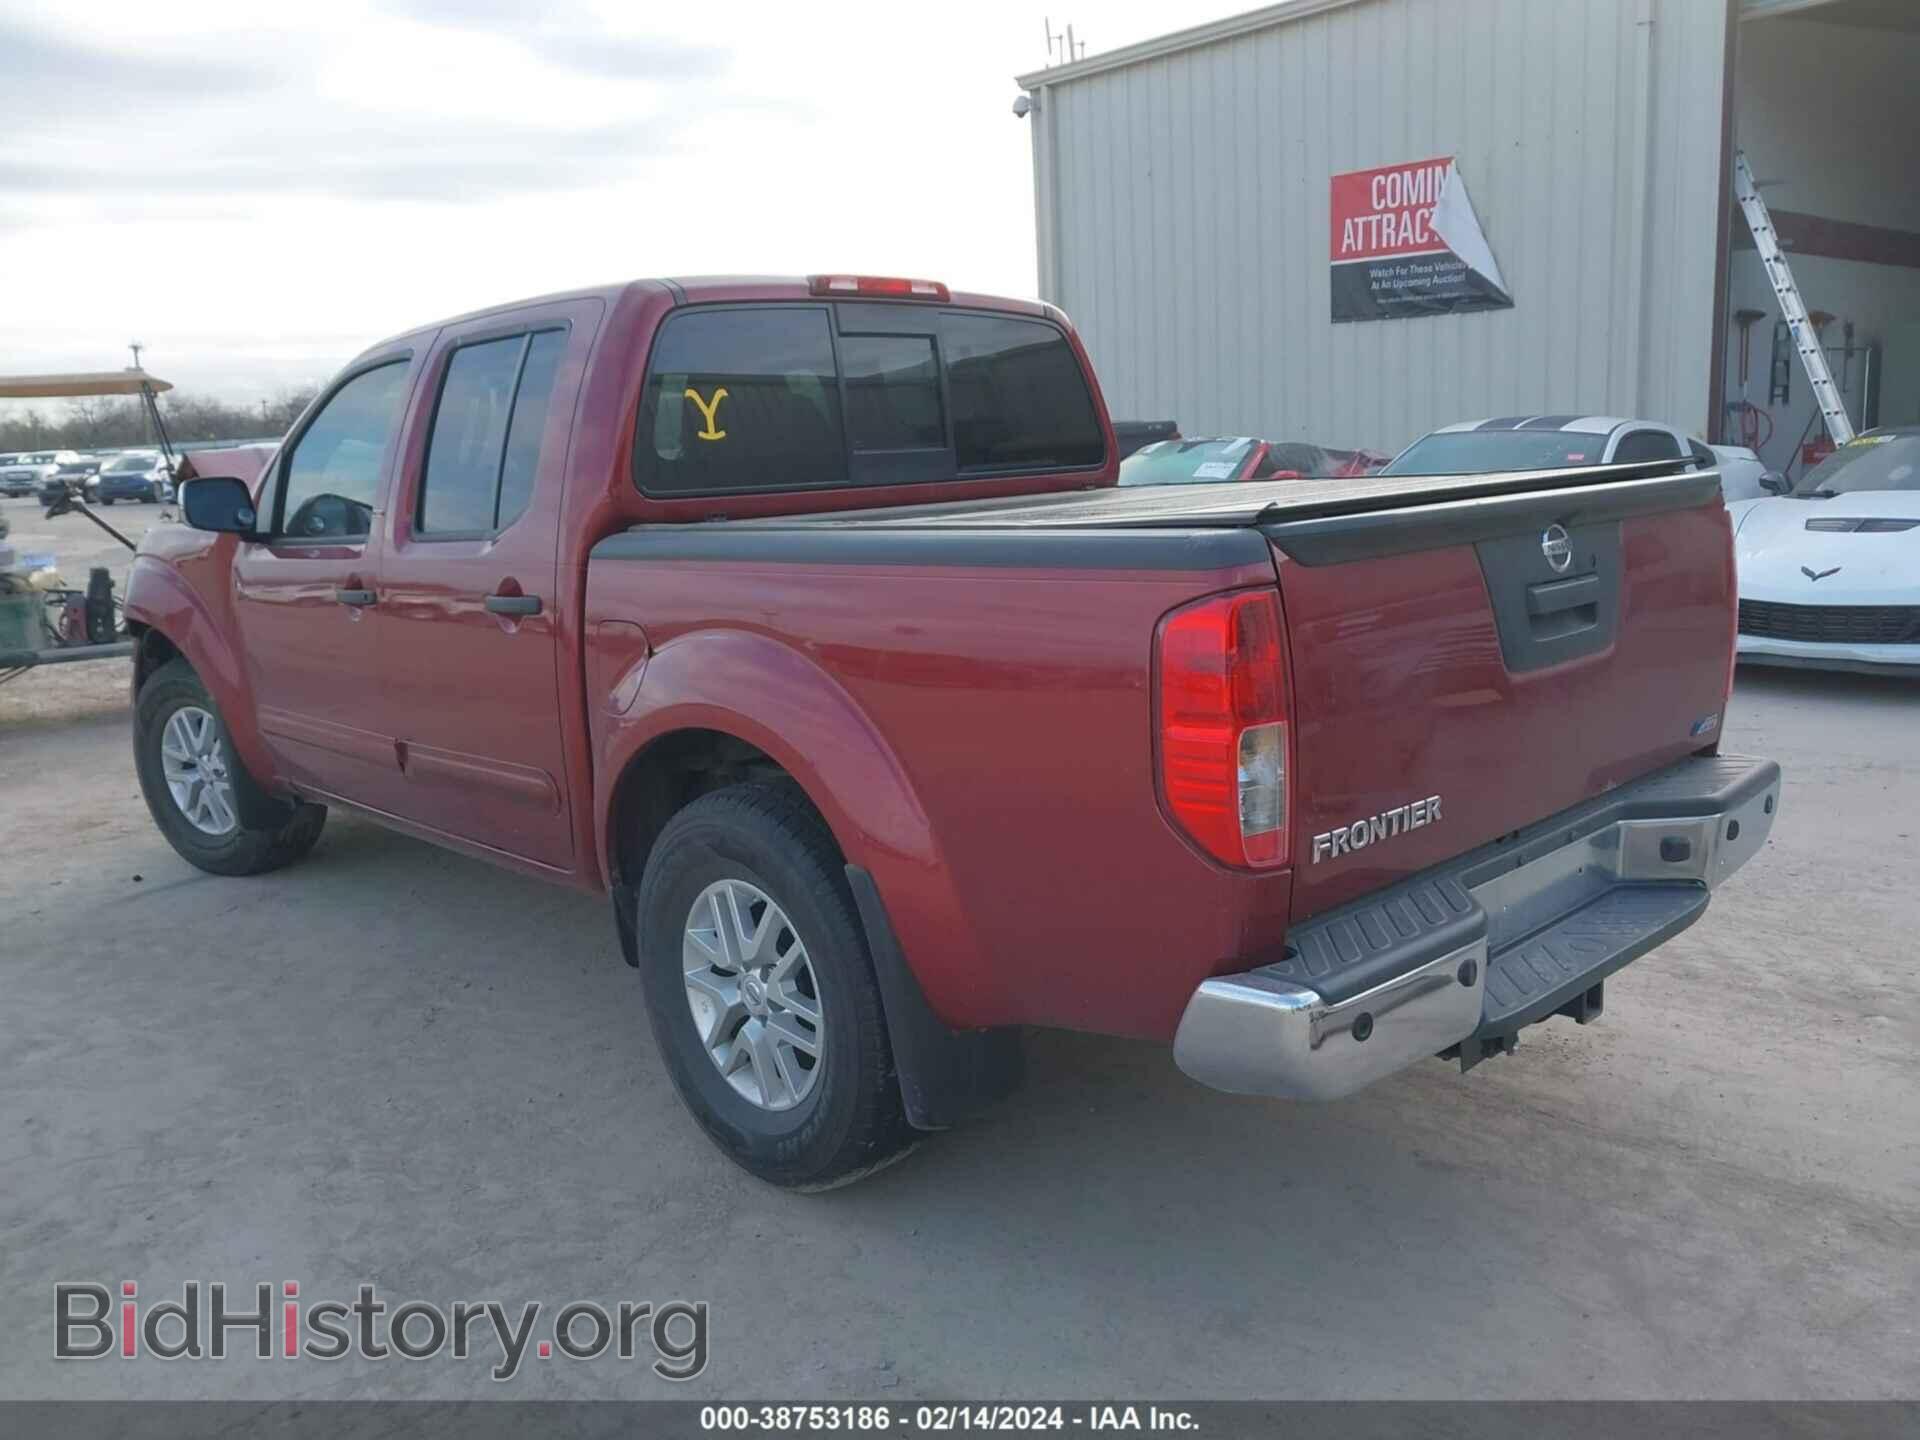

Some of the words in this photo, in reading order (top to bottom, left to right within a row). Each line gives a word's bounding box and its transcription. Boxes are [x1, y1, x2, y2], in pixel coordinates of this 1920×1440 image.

[1341, 208, 1440, 253] ATTRAC
[1369, 266, 1394, 278] Watch
[1395, 265, 1408, 276] For
[1409, 263, 1433, 274] These
[1371, 280, 1380, 289] At
[1381, 279, 1392, 288] An
[684, 387, 728, 440] Y
[1313, 795, 1442, 864] FRONTIER
